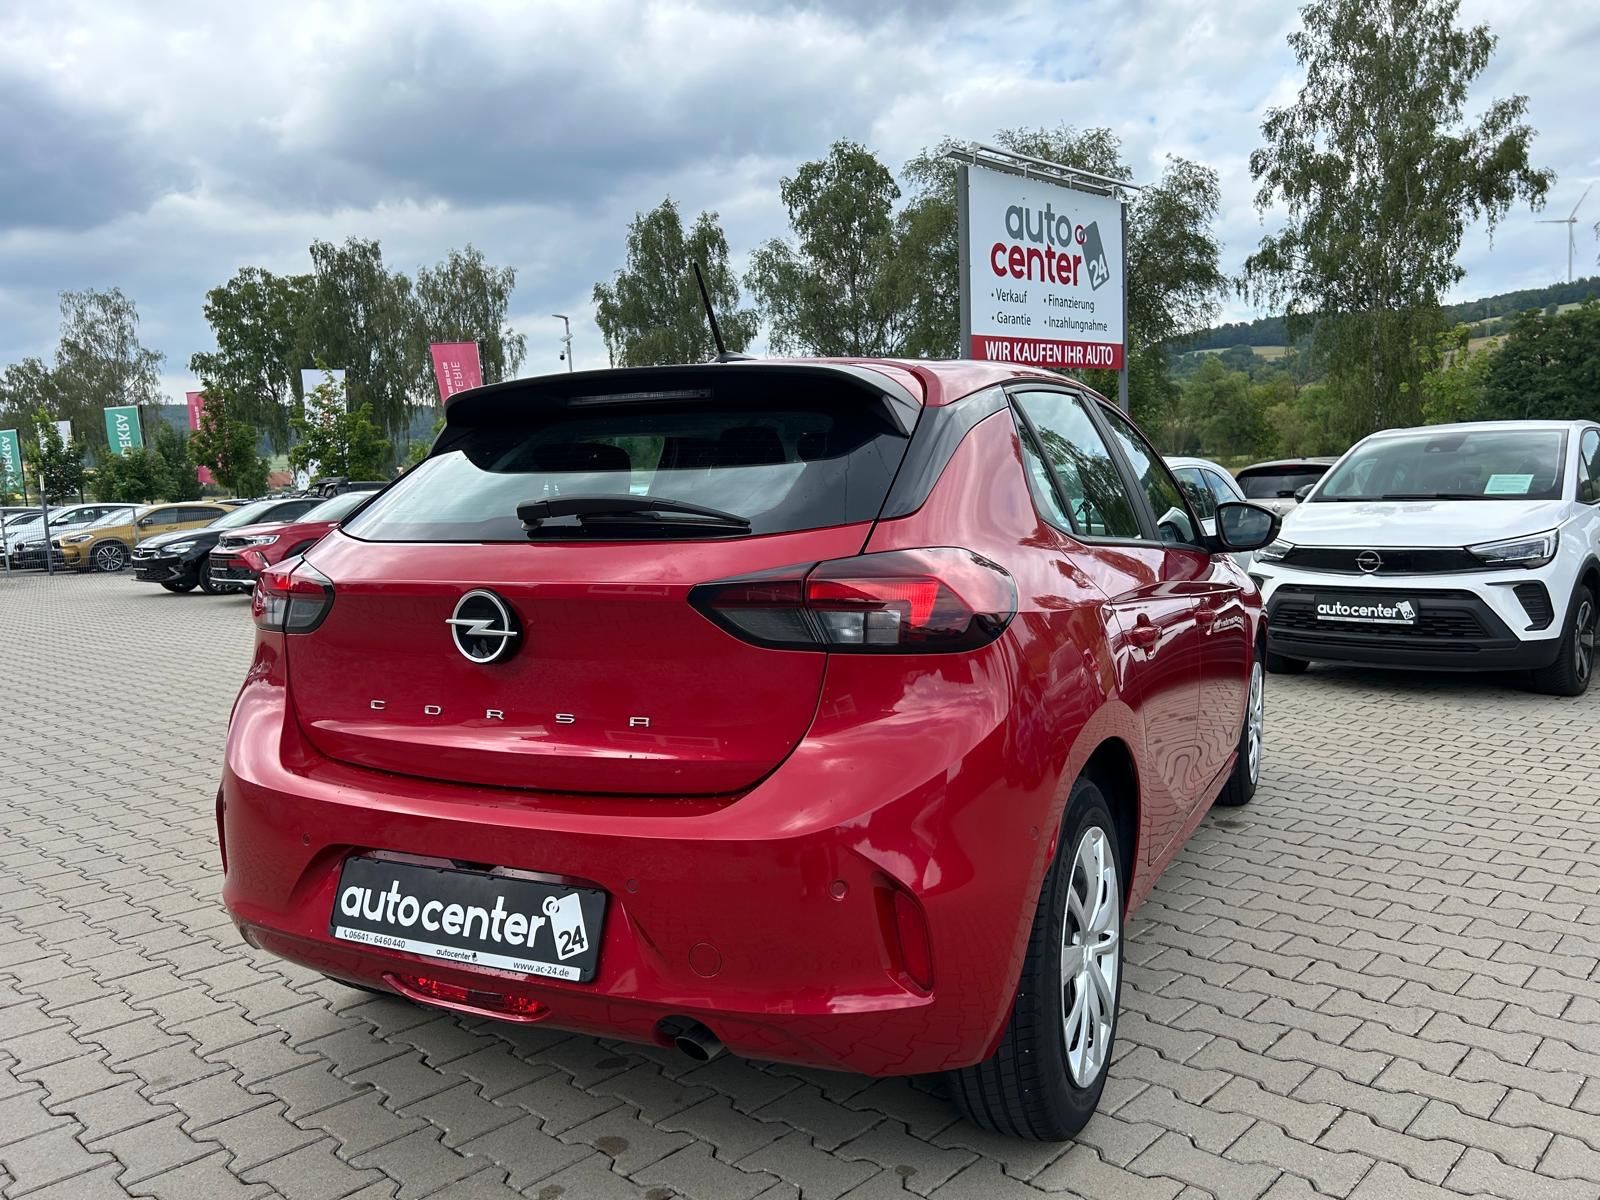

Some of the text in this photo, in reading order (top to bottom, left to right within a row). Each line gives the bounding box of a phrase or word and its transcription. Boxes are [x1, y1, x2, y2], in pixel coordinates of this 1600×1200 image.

[1005, 202, 1073, 247] auto
[990, 242, 1082, 286] center
[1089, 255, 1109, 285] 24
[996, 288, 1027, 304] Verkauf
[1048, 294, 1095, 313] Finanzierung
[997, 311, 1031, 326] Garantie
[1048, 316, 1108, 332] Inzahlungnahme
[985, 341, 1113, 365] WIR KAUFEN IHR AUTO
[1317, 601, 1398, 617] autocenter
[370, 700, 650, 727] CORSA
[340, 880, 585, 955] autocenter 24
[436, 948, 471, 961] autocenter
[513, 961, 570, 977] www.ac-24.de
